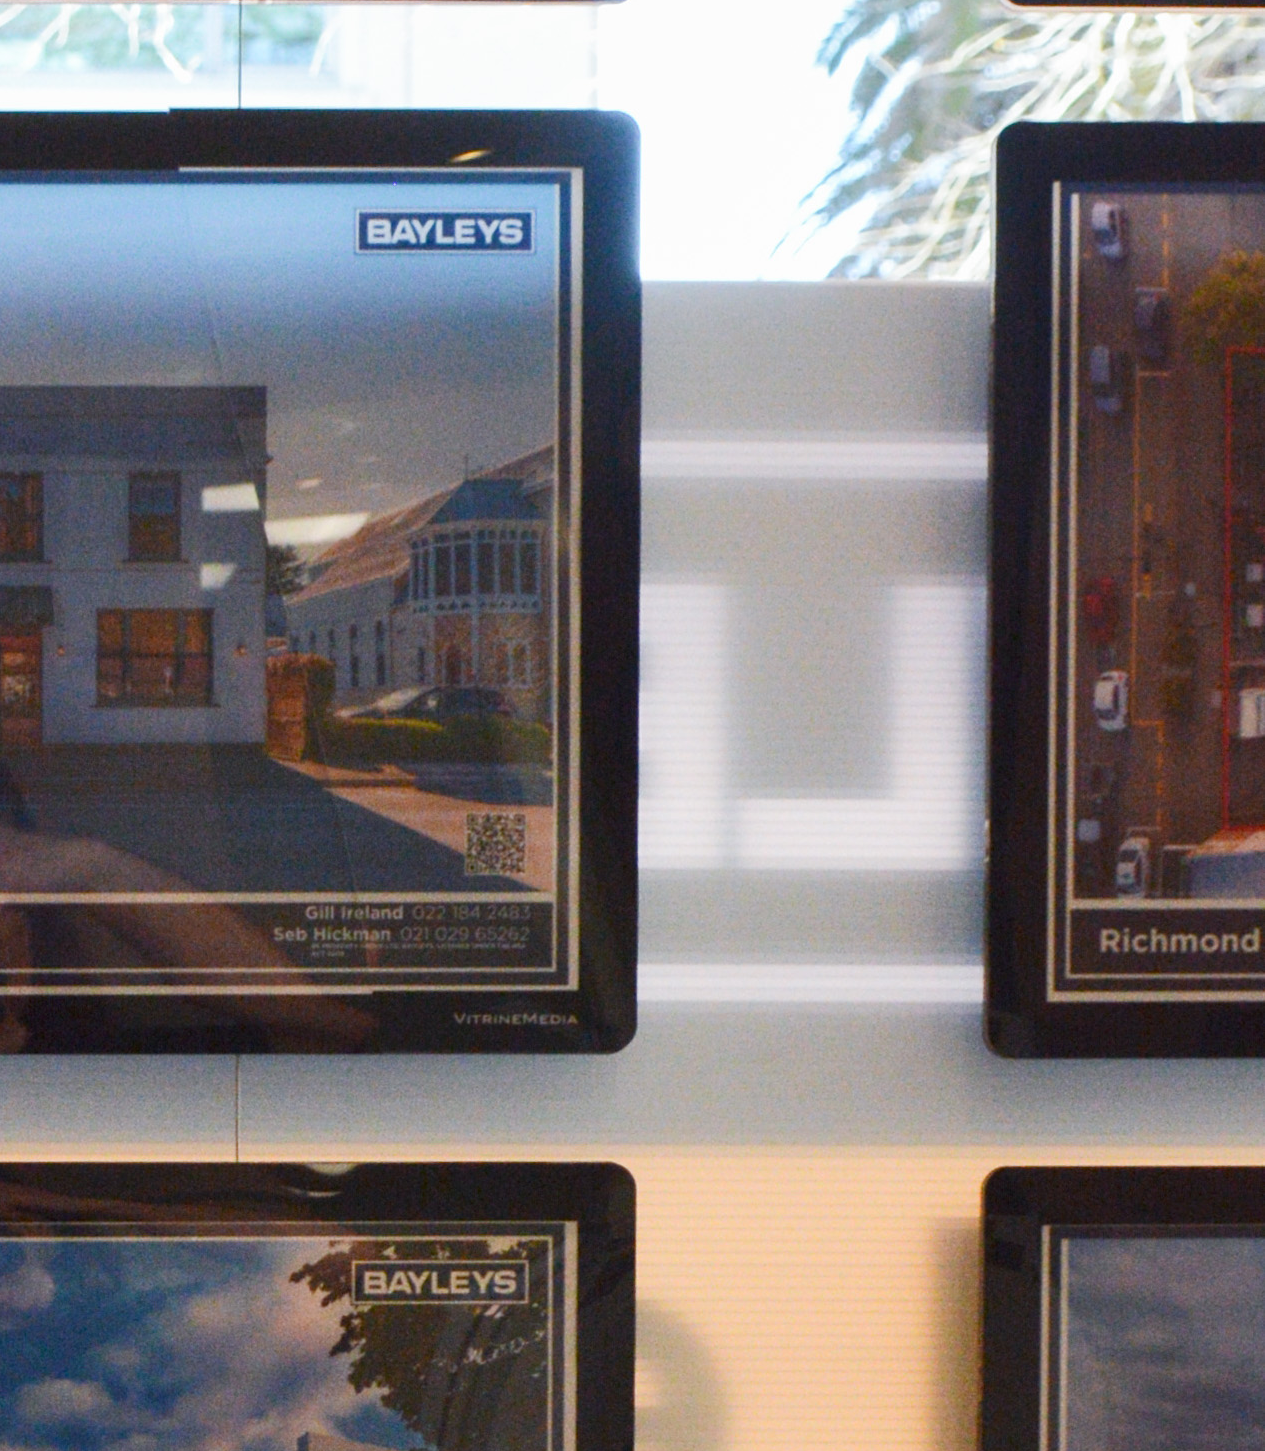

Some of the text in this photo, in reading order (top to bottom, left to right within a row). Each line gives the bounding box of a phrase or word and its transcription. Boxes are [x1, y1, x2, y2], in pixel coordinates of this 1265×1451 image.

[367, 218, 523, 245] BAYLEYS
[305, 905, 531, 921] Gill Ireland 022 184 2483
[274, 926, 531, 942] Seb Hickman 021 029 65262
[1099, 927, 1261, 954] Richmond
[363, 1270, 517, 1295] BAYLEYS
